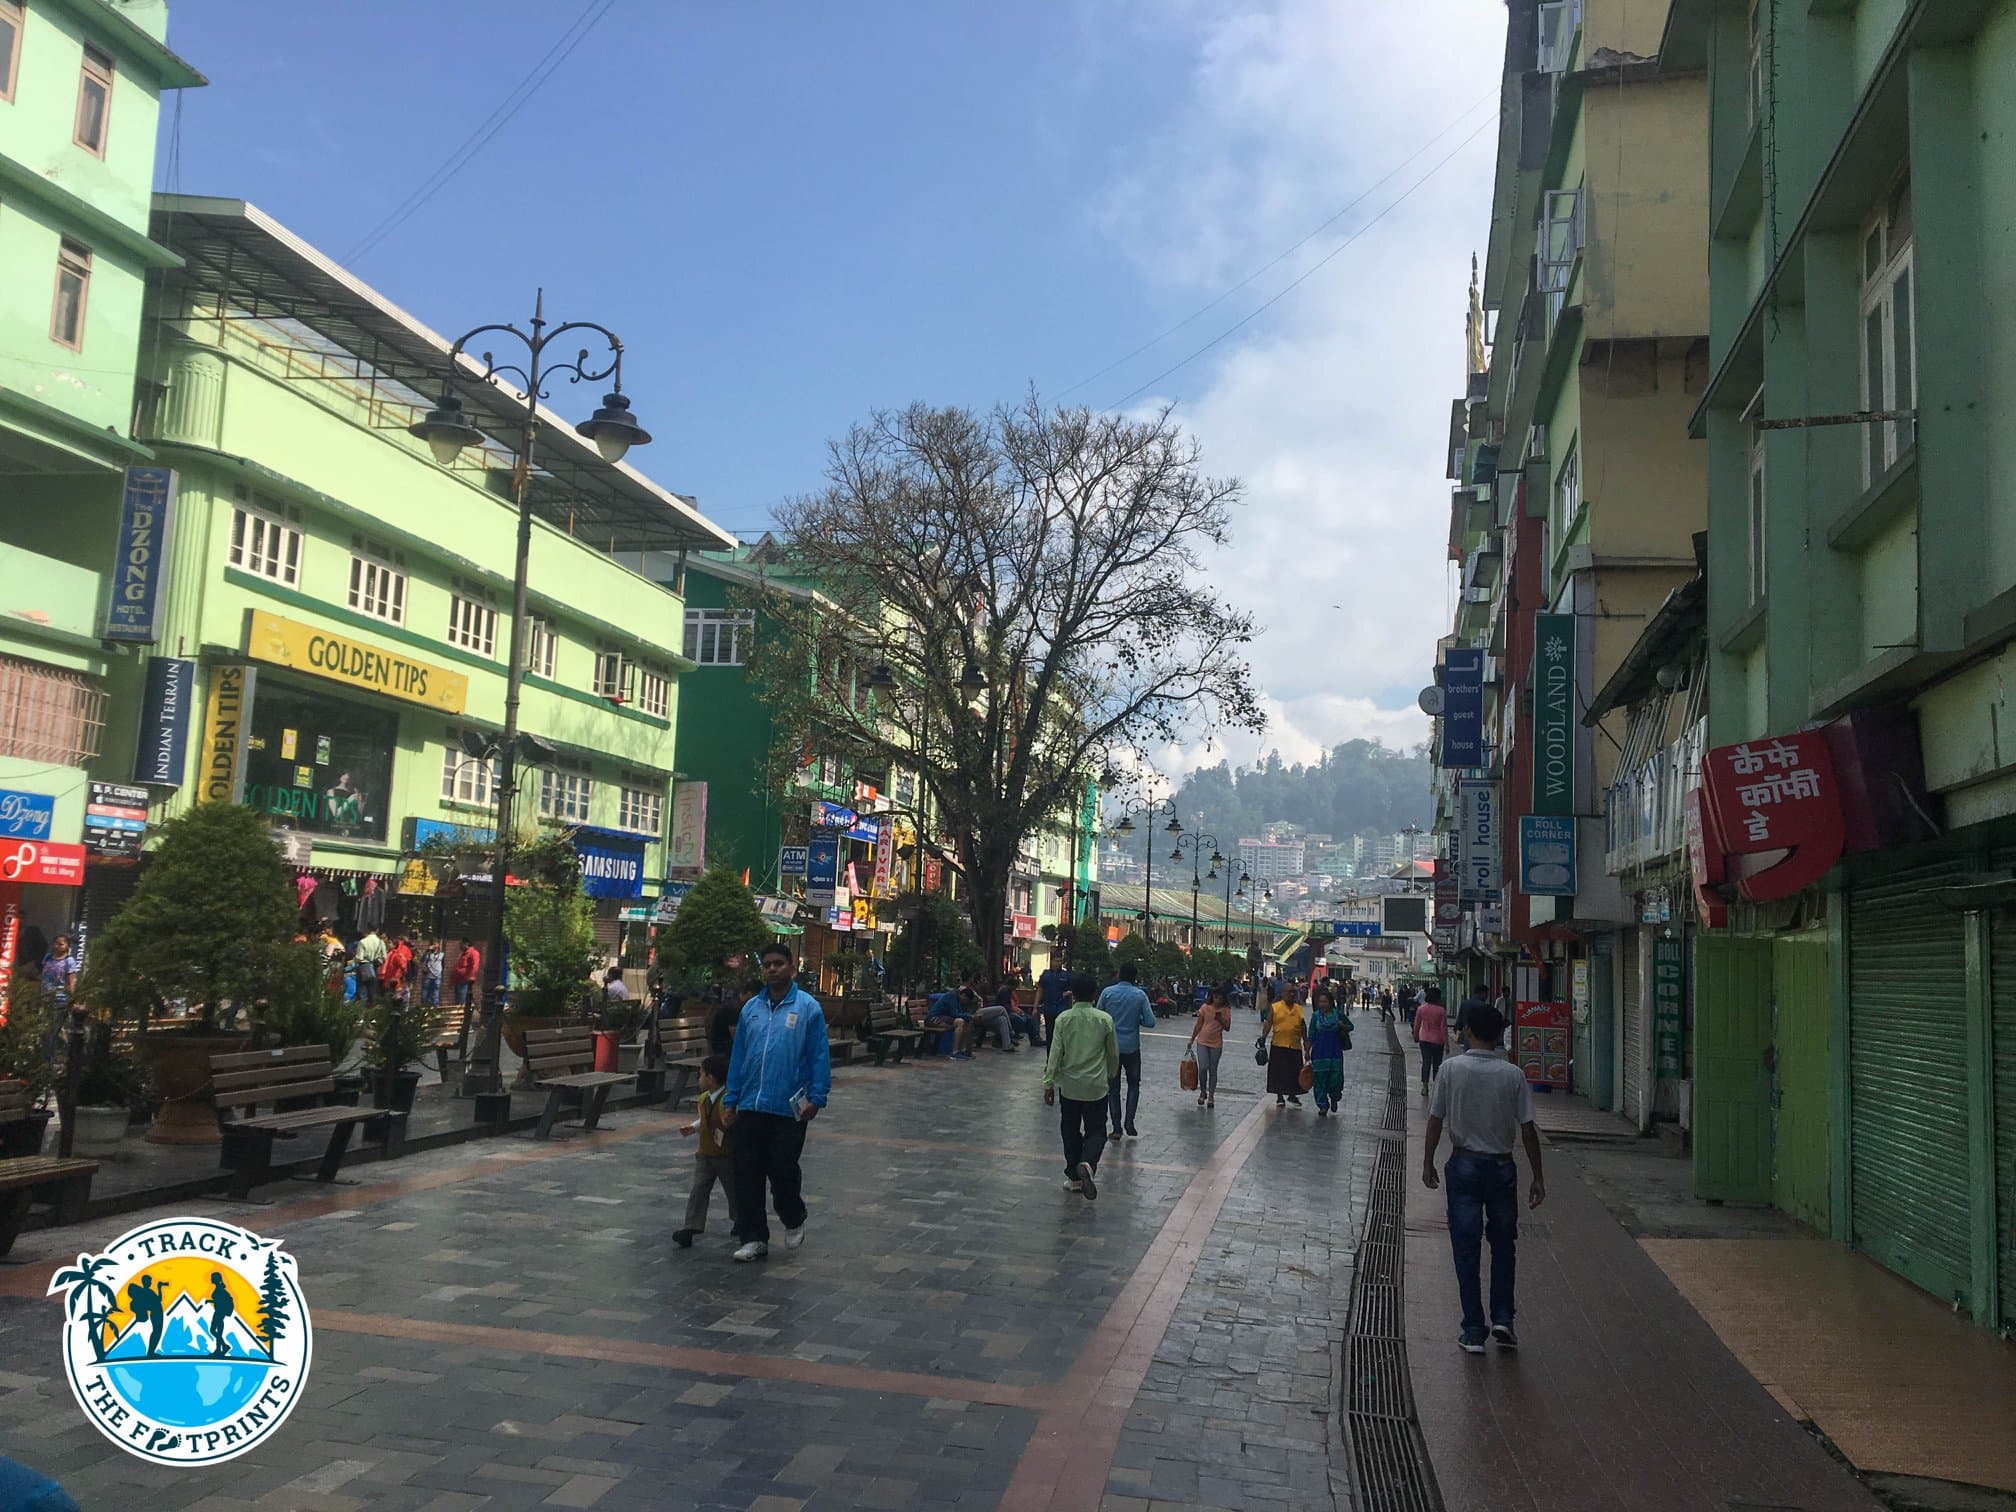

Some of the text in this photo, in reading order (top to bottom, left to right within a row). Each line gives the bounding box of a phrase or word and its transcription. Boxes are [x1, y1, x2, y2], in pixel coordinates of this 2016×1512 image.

[125, 512, 153, 600] DZONG
[116, 605, 146, 615] HOTEL
[308, 635, 428, 696] GOLDEN TIPS
[153, 662, 181, 780] INDIAN TERRAIN
[1453, 710, 1475, 720] guest
[208, 666, 242, 803] OLDEN TIPS
[1451, 739, 1475, 750] house
[1545, 664, 1569, 797] WOODLAND
[114, 787, 149, 799] CENTER
[1527, 830, 1571, 839] CORNER
[1535, 820, 1562, 829] ROLL
[1743, 809, 1769, 842] डे
[783, 850, 806, 860] ATM
[876, 820, 890, 883] PARIVAR
[578, 853, 637, 881] SAMSUNG
[1472, 856, 1490, 889] roll
[1658, 943, 1680, 961] ROLL
[1657, 964, 1680, 1070] CORNER
